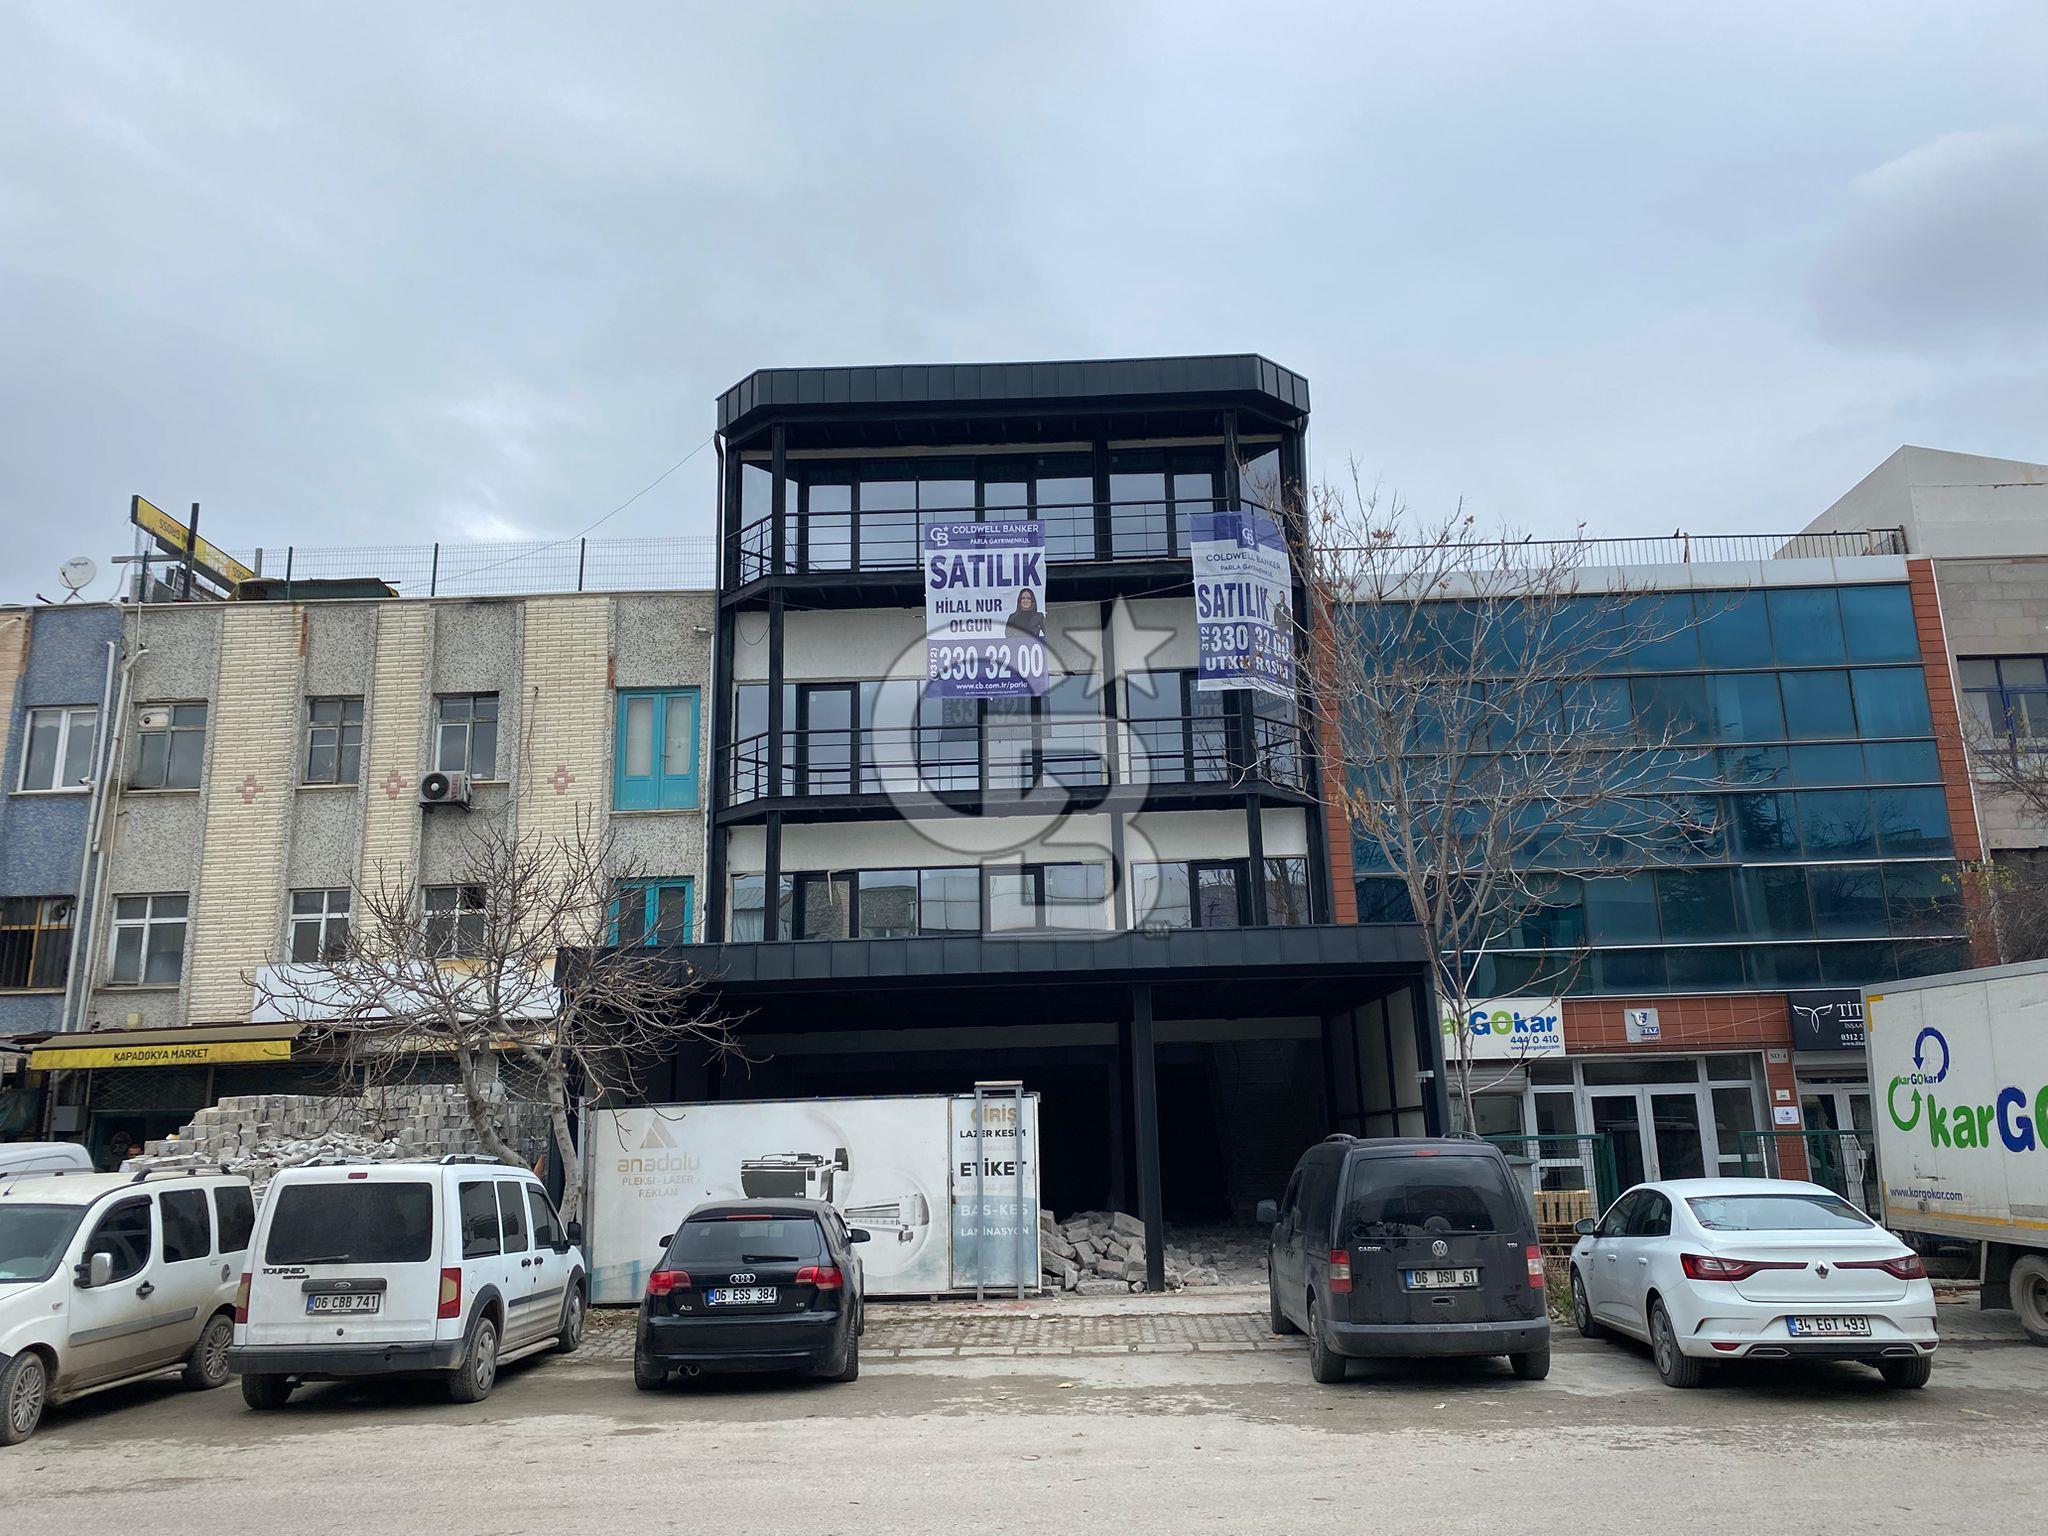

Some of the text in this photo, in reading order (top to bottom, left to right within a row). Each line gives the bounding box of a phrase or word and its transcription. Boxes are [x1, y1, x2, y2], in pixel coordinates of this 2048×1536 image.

[952, 524, 1039, 534] COLDWELL BANKER
[1206, 552, 1281, 570] COLDWELL BANKER
[930, 552, 1042, 590] SATILIK
[936, 597, 1003, 614] HİLAL NUR
[1198, 583, 1270, 621] SATILIK
[949, 618, 992, 633] OLGUN
[1210, 625, 1249, 652] 330
[930, 643, 1044, 681] (0312) 330 32 00
[1542, 1035, 1559, 1043] 410
[113, 1048, 209, 1061] KAPADOKYA MARKET
[1897, 1073, 1938, 1085] karGOkar
[1927, 1085, 2048, 1153] karG
[617, 1152, 700, 1172] anadolu
[663, 1175, 694, 1185] LAZER
[638, 1187, 678, 1198] REKLAM
[1890, 1187, 1963, 1201] www.kargokar.com
[262, 1267, 305, 1275] TOURNEO
[1415, 1270, 1475, 1284] 06 DSU 61
[715, 1288, 775, 1301] 06 ESS 384
[315, 1295, 376, 1309] 06 CBB 741
[1796, 1317, 1866, 1331] 34 EGT 493
